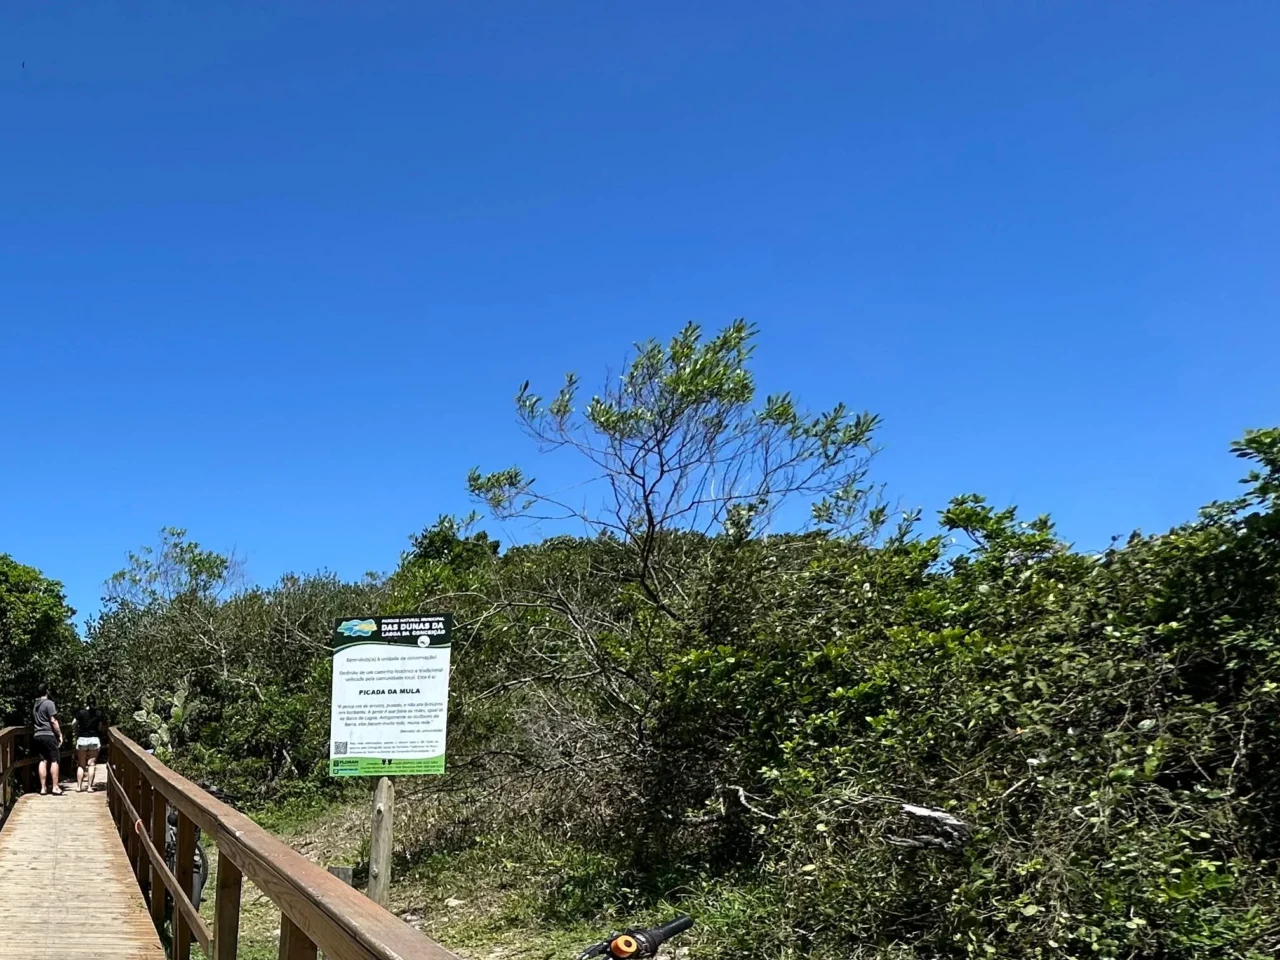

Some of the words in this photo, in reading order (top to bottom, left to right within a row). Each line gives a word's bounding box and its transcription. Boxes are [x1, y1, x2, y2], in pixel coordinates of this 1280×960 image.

[381, 623, 399, 631] DAS
[400, 622, 430, 631] DUNAS
[432, 621, 444, 630] DA
[412, 629, 446, 637] CONCEIÇÃO
